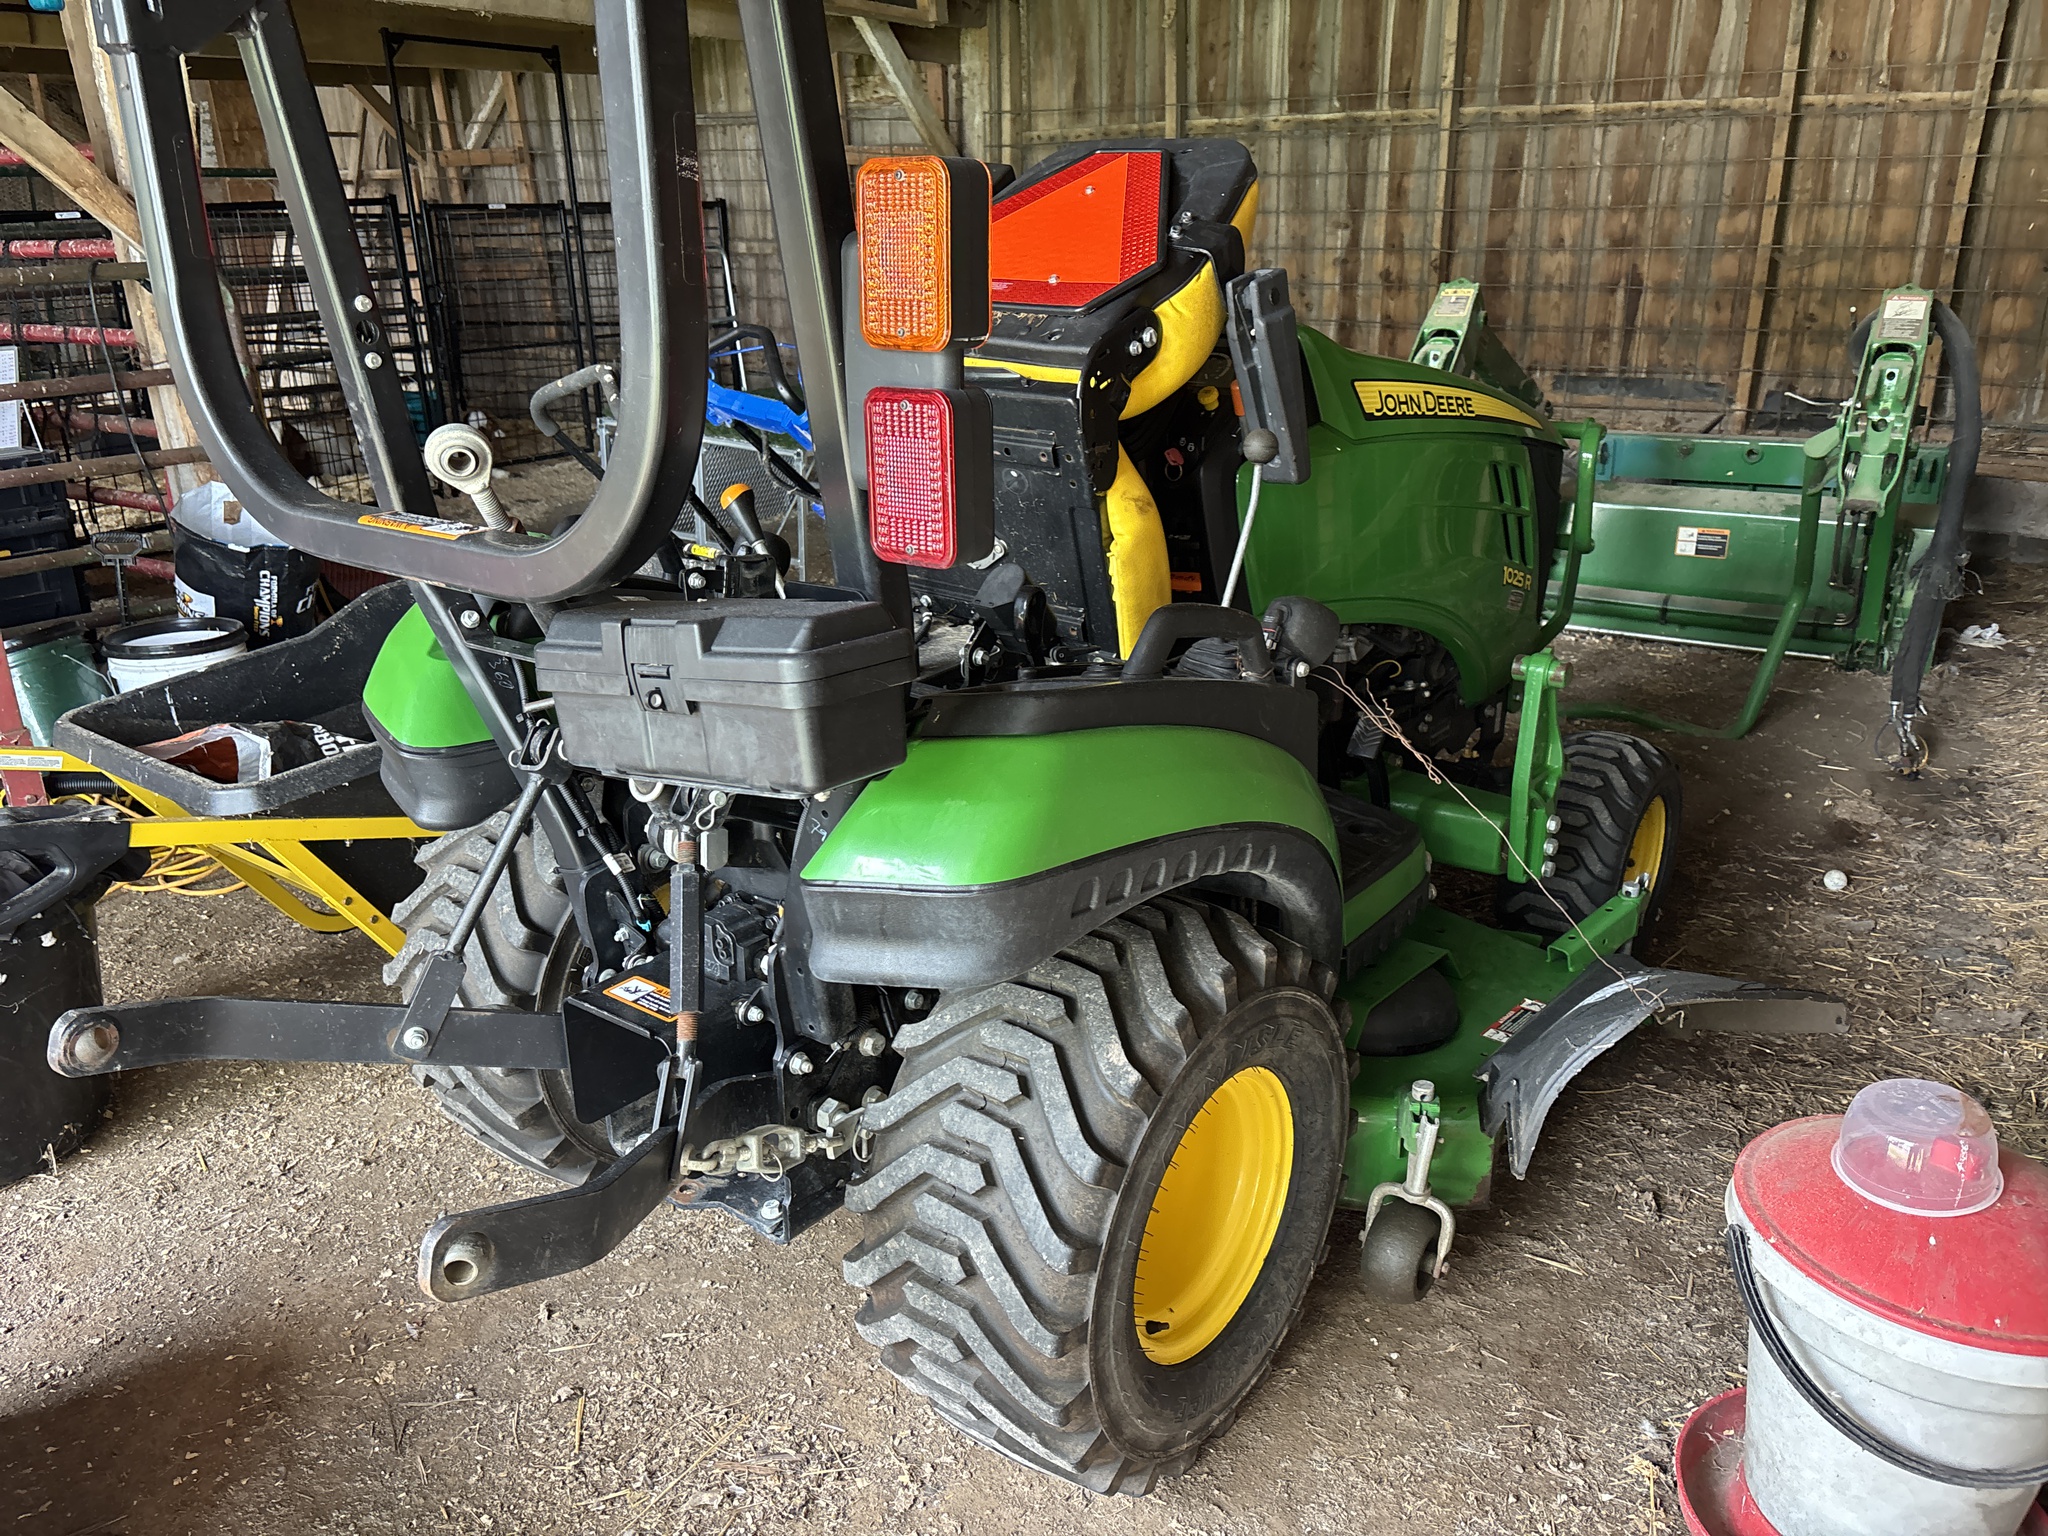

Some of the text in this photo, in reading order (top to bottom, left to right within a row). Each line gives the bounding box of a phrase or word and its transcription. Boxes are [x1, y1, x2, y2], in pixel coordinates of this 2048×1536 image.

[1375, 390, 1475, 414] JOHN DEERE
[253, 570, 271, 638] CHAMPIONS
[270, 575, 278, 619] FORMULA OF
